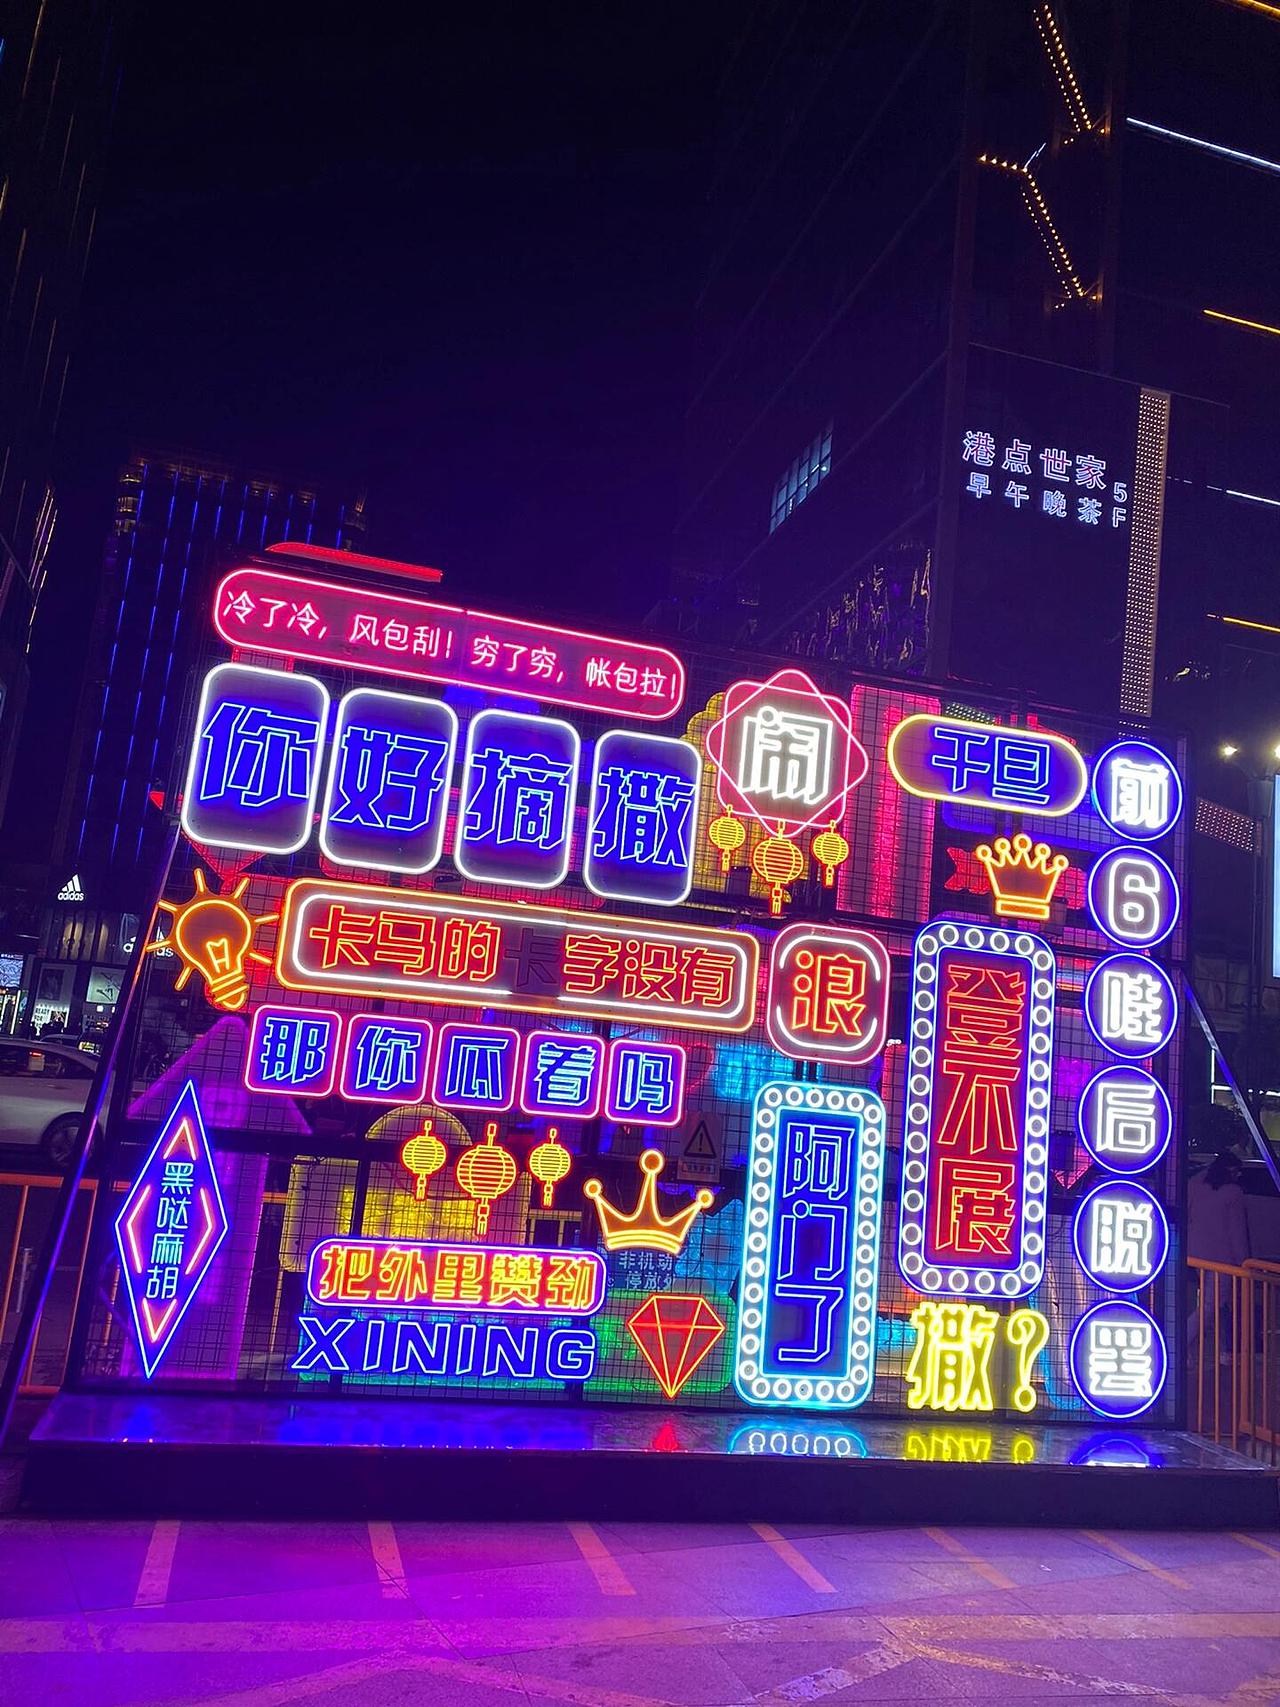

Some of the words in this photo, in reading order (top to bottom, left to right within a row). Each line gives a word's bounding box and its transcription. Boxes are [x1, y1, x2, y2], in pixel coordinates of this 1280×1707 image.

[962, 430, 1107, 490] 港点世家
[966, 471, 1102, 525] 早午晚茶
[1112, 481, 1128, 528] 5F
[738, 705, 834, 805] 闹
[932, 727, 1051, 805] 干旦
[57, 890, 85, 901] adidas
[309, 905, 737, 1009] 卡马的卡字没有
[791, 948, 868, 1036] 浪
[260, 1016, 675, 1114] 那你瓜着吗
[936, 964, 1026, 1255] 登不展
[145, 1161, 194, 1299] 黑哒麻胡
[775, 1122, 858, 1363] 阿门了
[319, 1244, 598, 1309] 把外里赞劲
[291, 1316, 598, 1380] XINING
